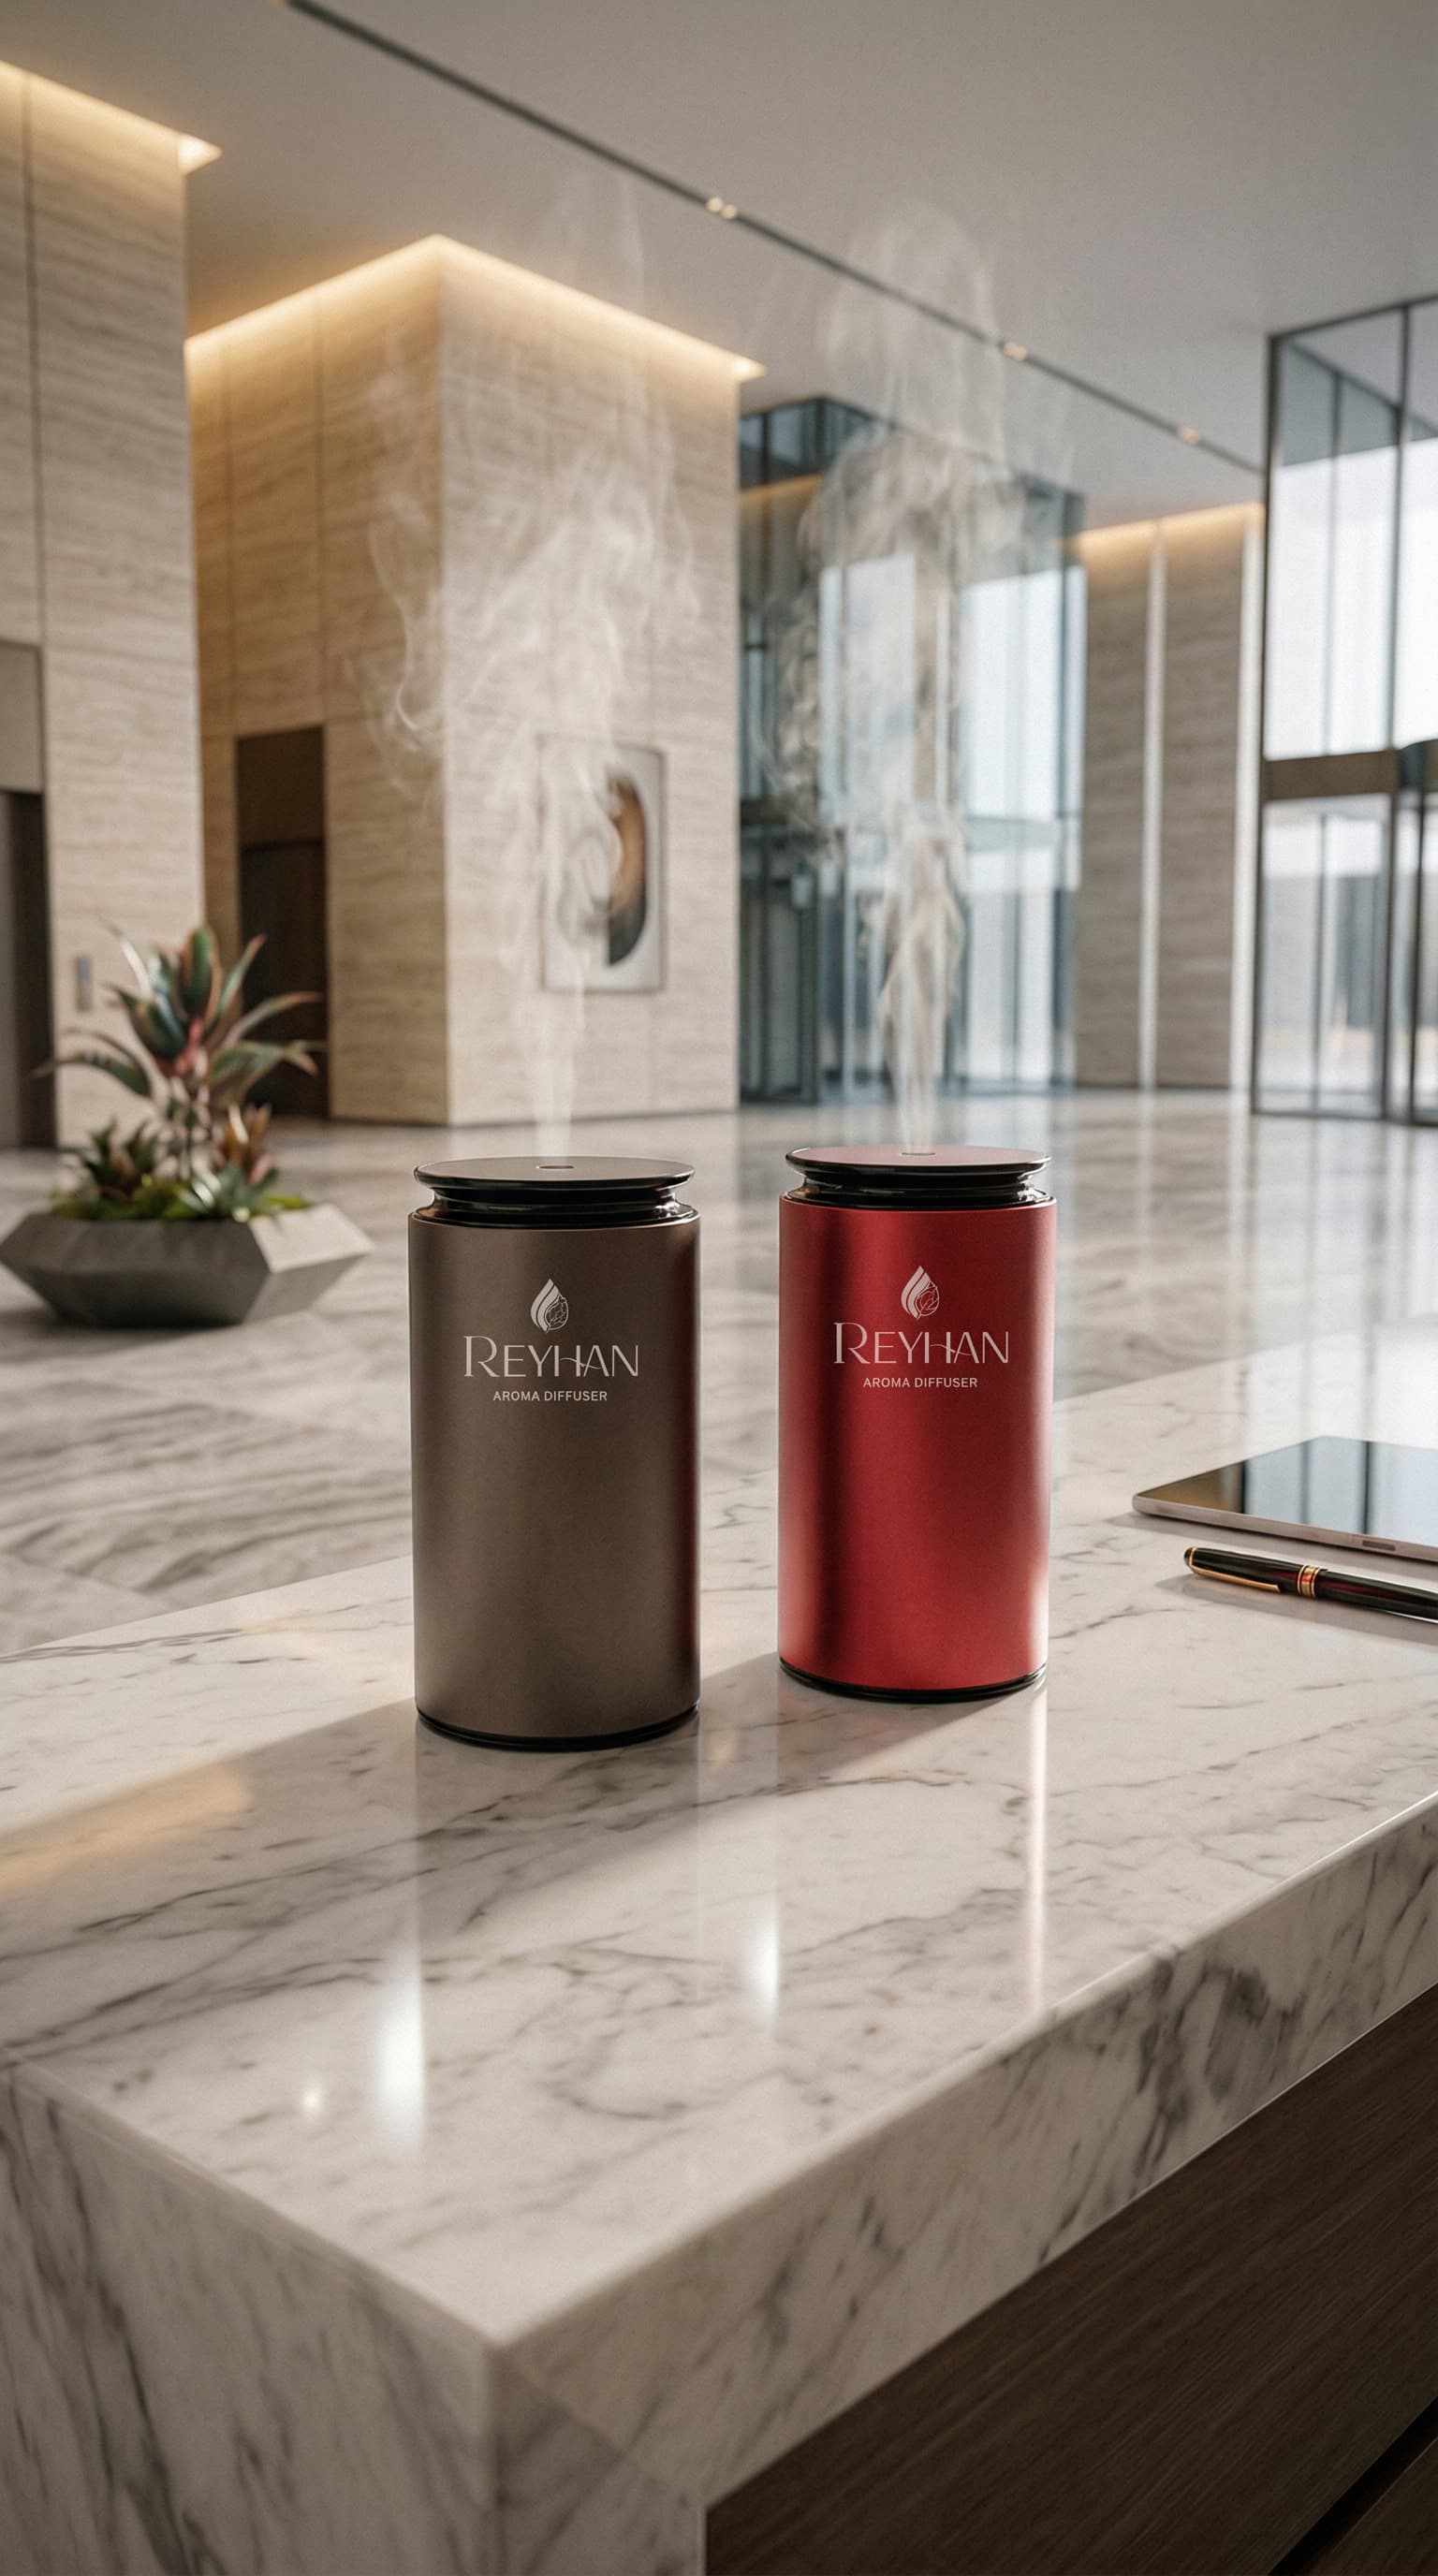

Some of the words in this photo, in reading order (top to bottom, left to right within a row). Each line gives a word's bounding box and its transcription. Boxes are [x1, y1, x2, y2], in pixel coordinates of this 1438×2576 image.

[833, 1322, 1009, 1364] REYHAN
[463, 1335, 638, 1378] REYHAN
[492, 1390, 540, 1401] AROMA
[544, 1390, 608, 1401] DIFFUSER
[863, 1377, 910, 1388] AROMA
[914, 1377, 978, 1388] DIFFUSER
